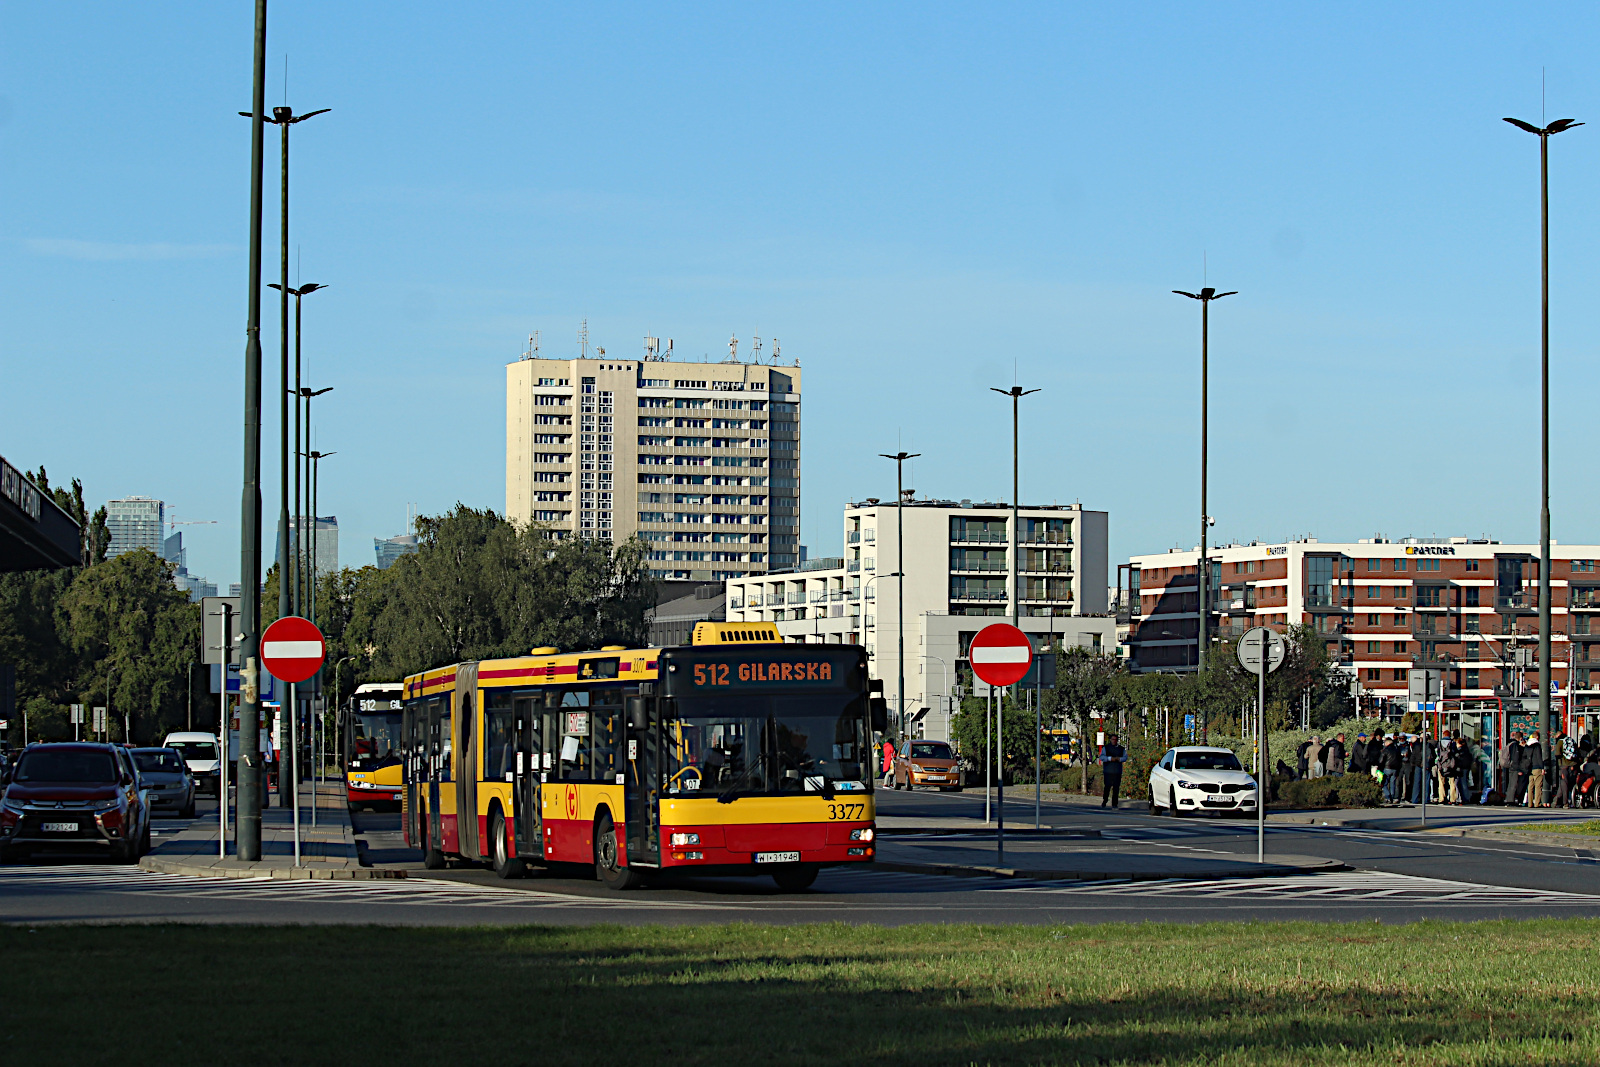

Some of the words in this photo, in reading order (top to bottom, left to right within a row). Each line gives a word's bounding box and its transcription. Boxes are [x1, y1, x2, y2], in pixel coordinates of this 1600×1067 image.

[1413, 546, 1456, 556] PARTNER
[694, 663, 730, 686] 512
[738, 662, 832, 681] GILARSKA
[360, 700, 377, 711] 512
[827, 804, 865, 820] 3377
